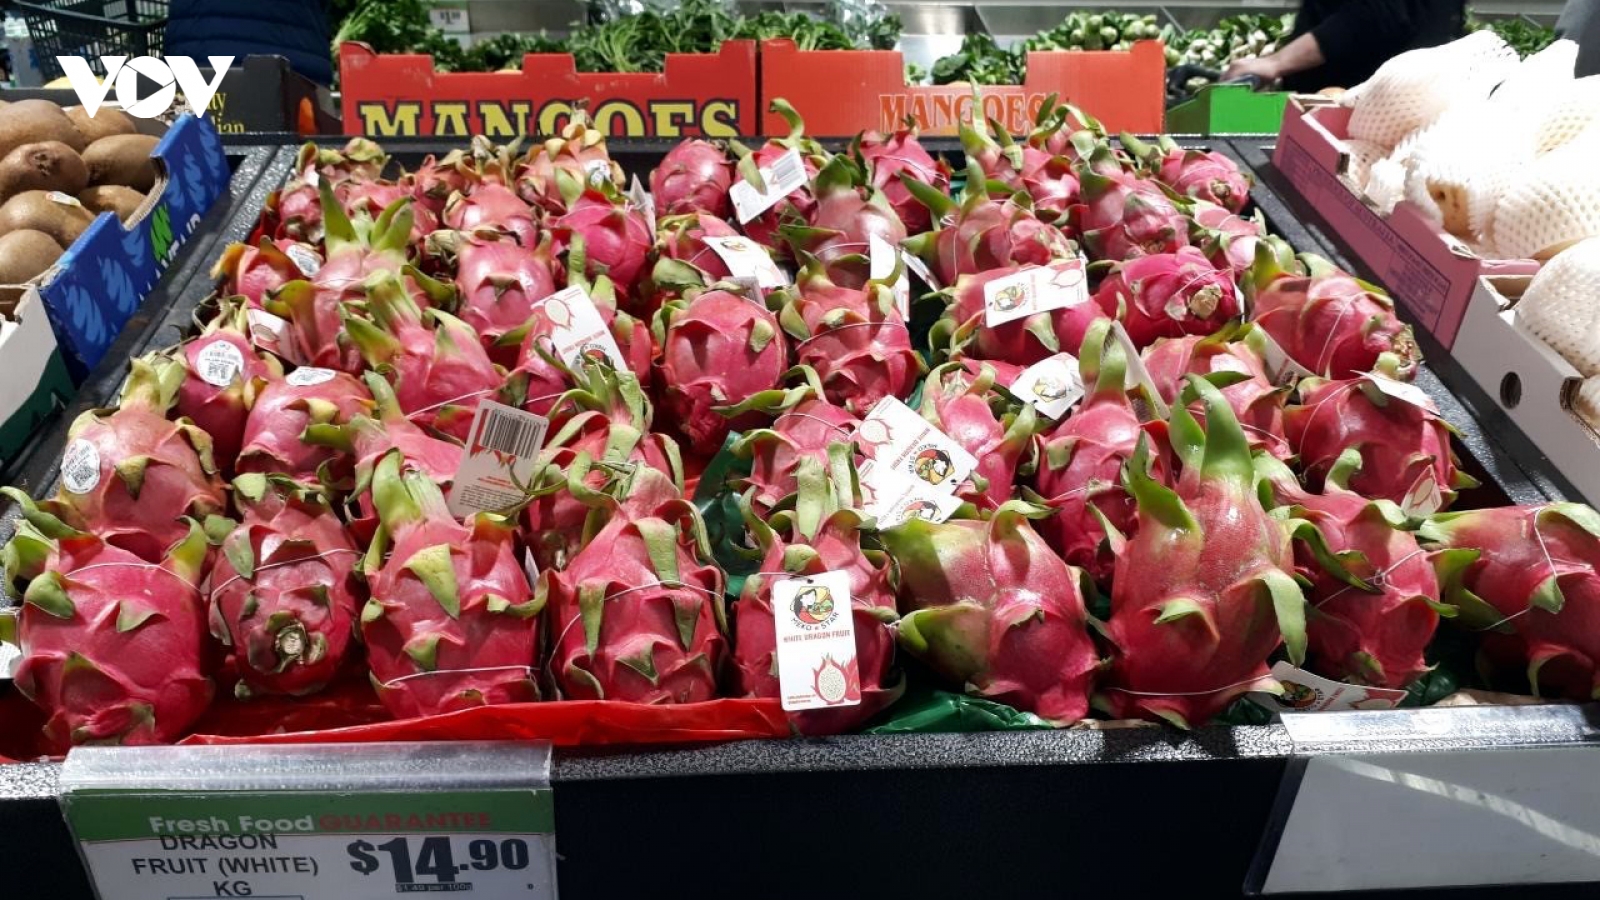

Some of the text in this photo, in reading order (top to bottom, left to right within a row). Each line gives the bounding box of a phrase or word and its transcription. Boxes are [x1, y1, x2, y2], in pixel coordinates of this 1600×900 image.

[820, 612, 840, 630] STAR
[831, 629, 851, 638] FRUIT
[148, 812, 491, 833] Fresh Food GUARANTEE
[160, 833, 278, 850] DRAGON
[131, 857, 319, 877] FRUIT (WHITE)
[346, 836, 530, 884] $14.90
[213, 880, 253, 896] KG
